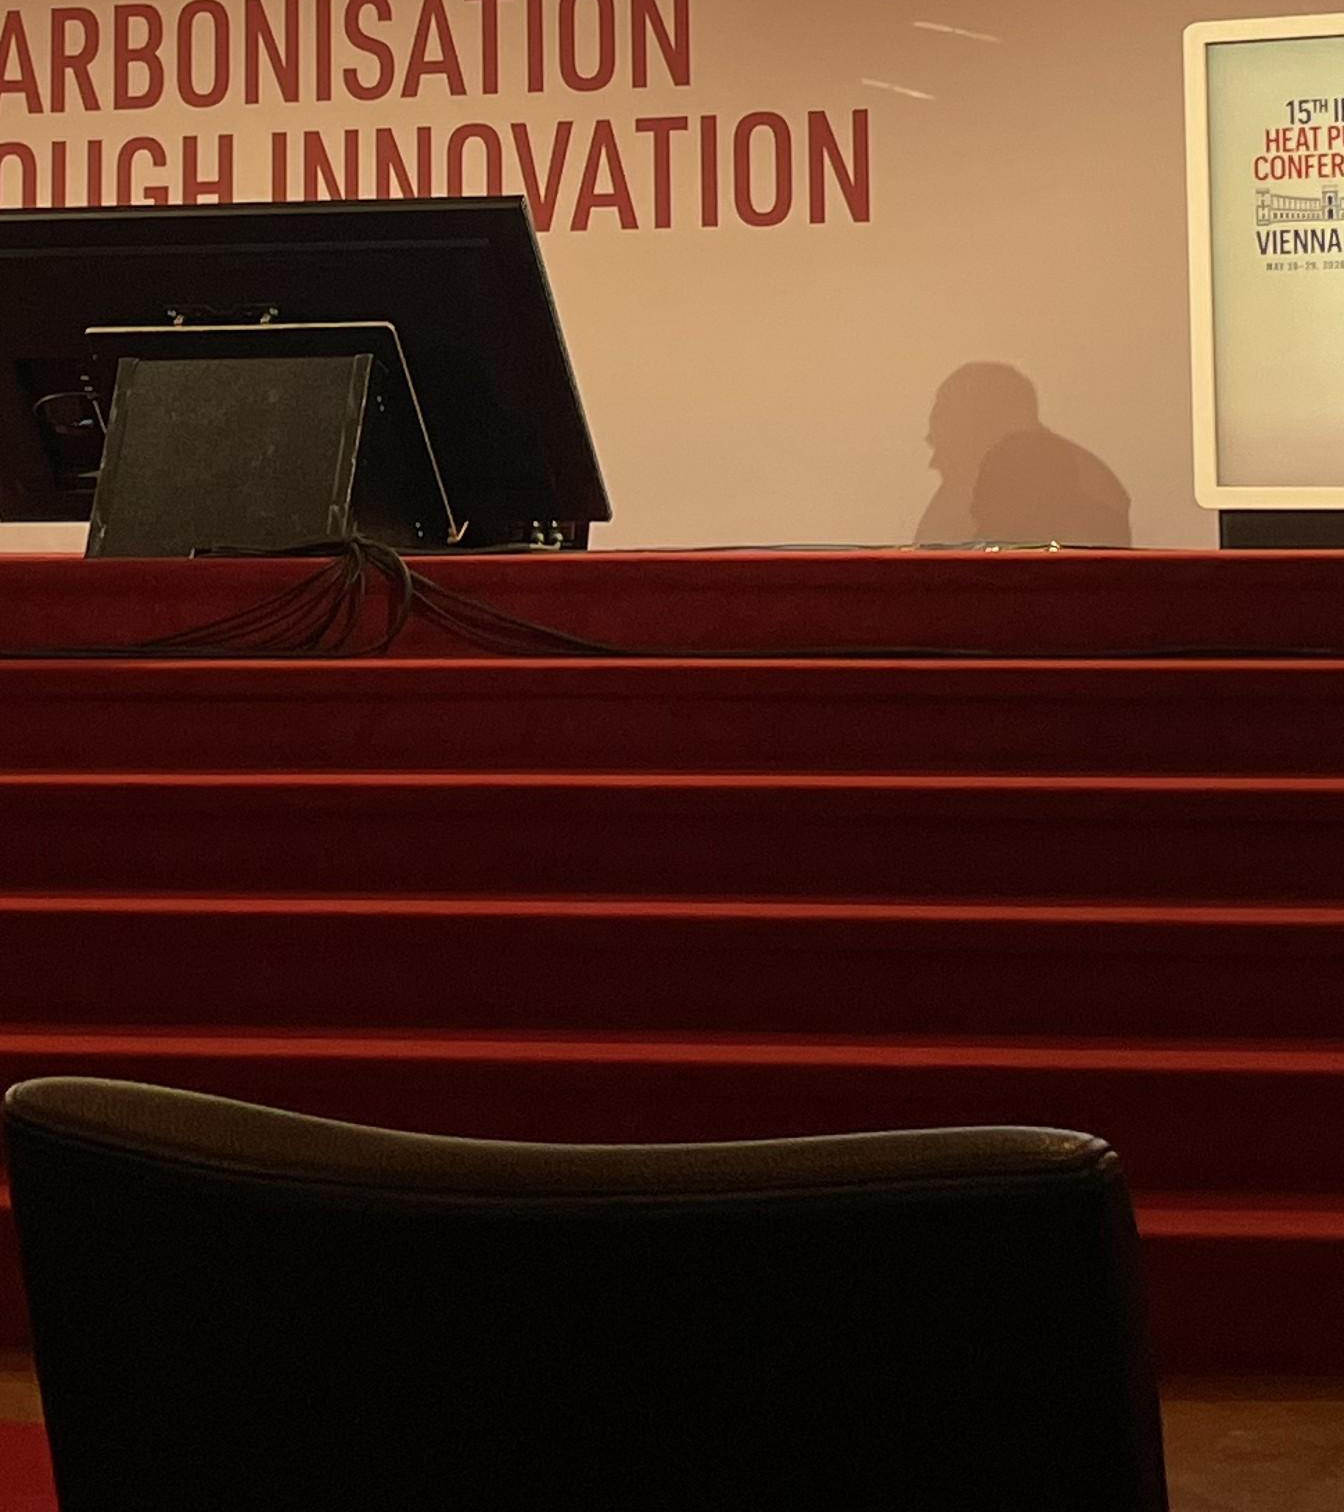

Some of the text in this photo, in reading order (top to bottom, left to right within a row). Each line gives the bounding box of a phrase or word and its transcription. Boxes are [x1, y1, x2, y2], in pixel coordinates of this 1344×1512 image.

[1286, 99, 1328, 125] 15TH
[1265, 126, 1322, 153] HEAT
[271, 109, 871, 233] INNOVATION
[1256, 228, 1342, 255] VIENNA
